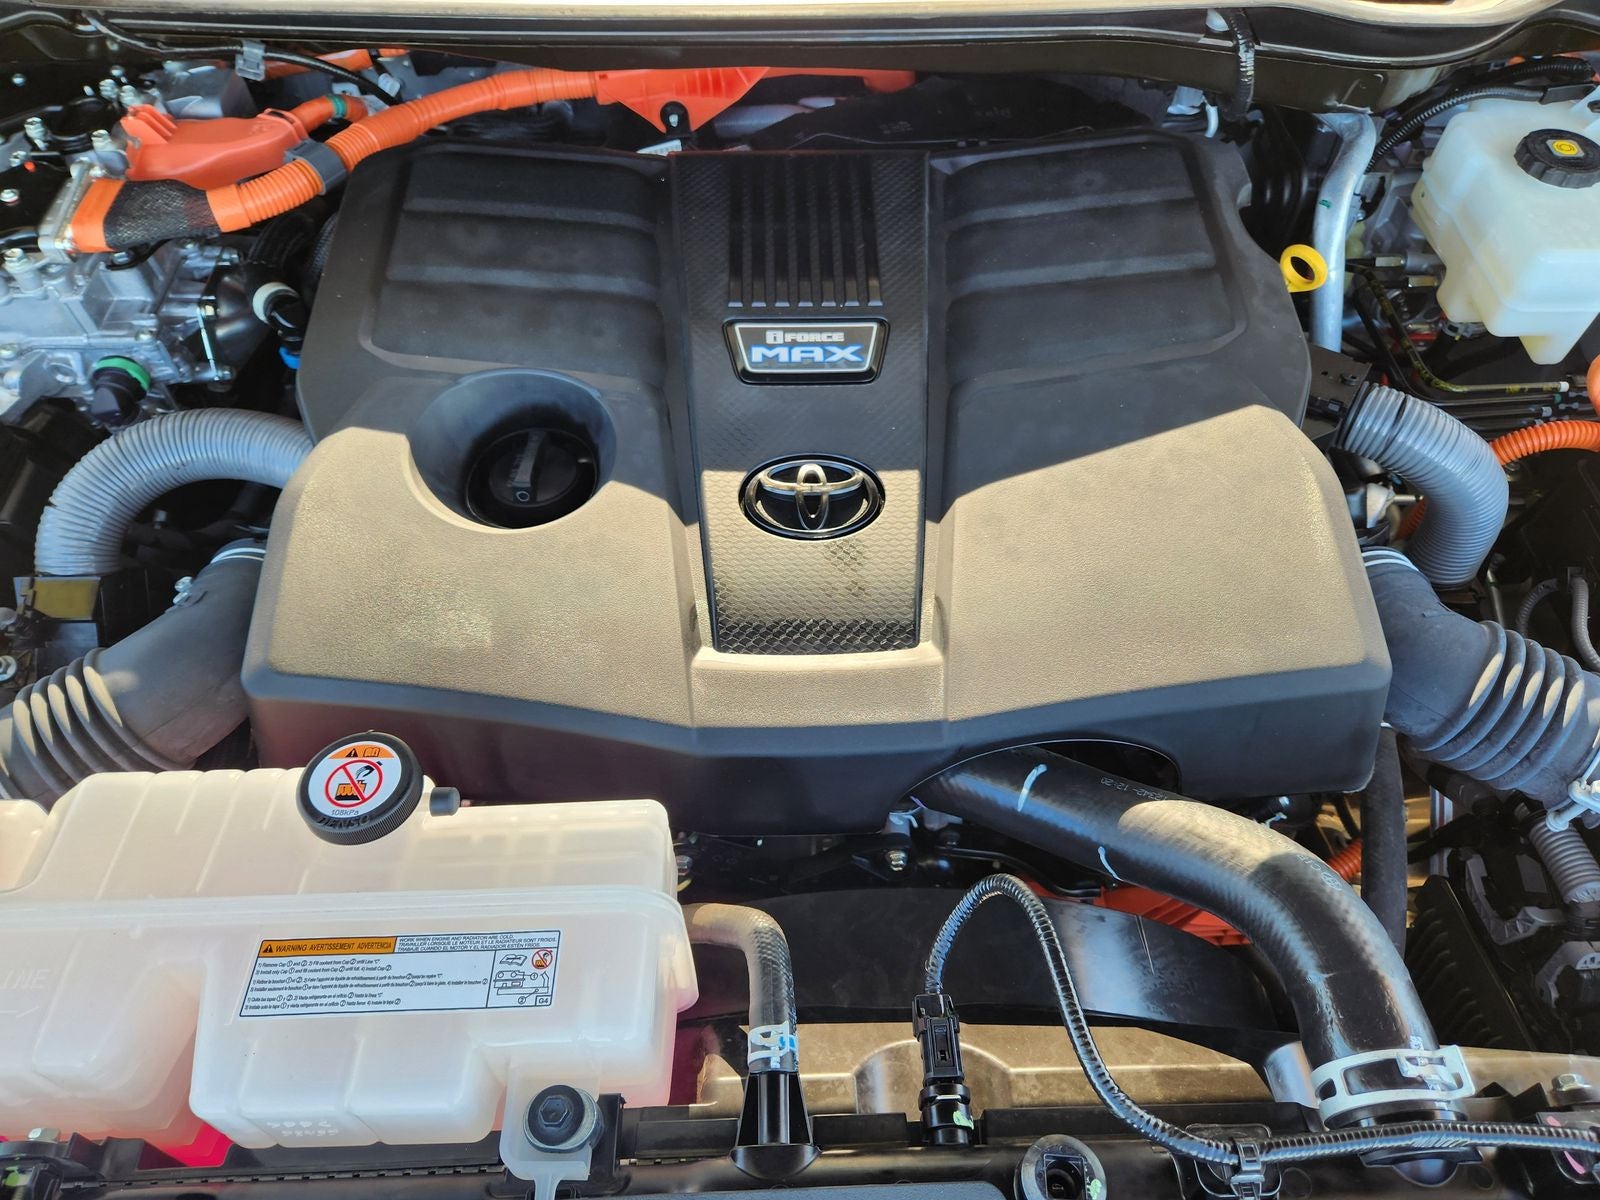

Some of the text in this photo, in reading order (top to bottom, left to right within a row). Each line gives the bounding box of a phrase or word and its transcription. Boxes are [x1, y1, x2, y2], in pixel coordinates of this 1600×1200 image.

[750, 345, 865, 363] MAX
[316, 814, 371, 830] DENSO
[275, 943, 307, 953] WARNING
[309, 942, 355, 951] AVERTISSEMENT
[538, 997, 549, 1005] G4
